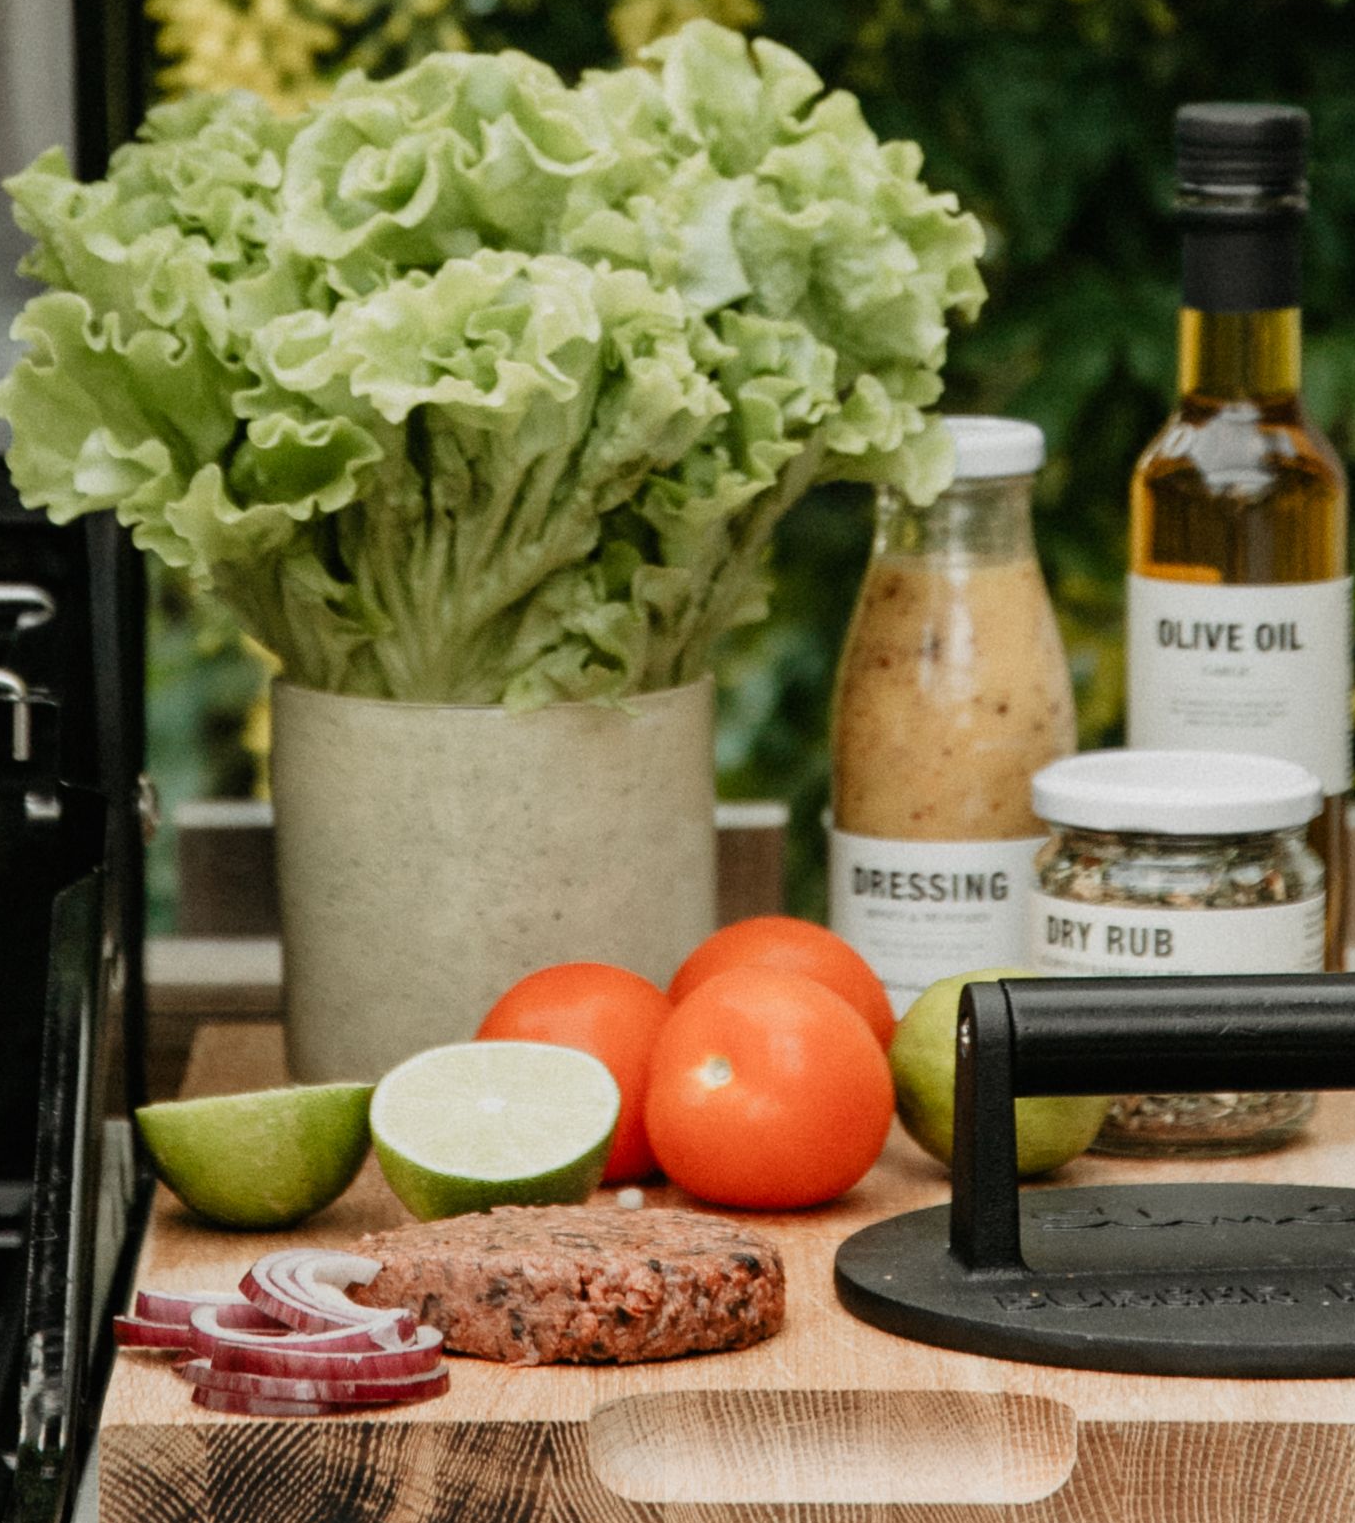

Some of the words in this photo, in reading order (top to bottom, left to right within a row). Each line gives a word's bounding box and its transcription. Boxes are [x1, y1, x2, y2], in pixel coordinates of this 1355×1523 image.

[1158, 619, 1243, 651] OLIVE
[1255, 621, 1303, 651] OIL
[852, 867, 1009, 901] DRESSING
[1046, 915, 1092, 951] DRY
[1106, 925, 1174, 957] RUB
